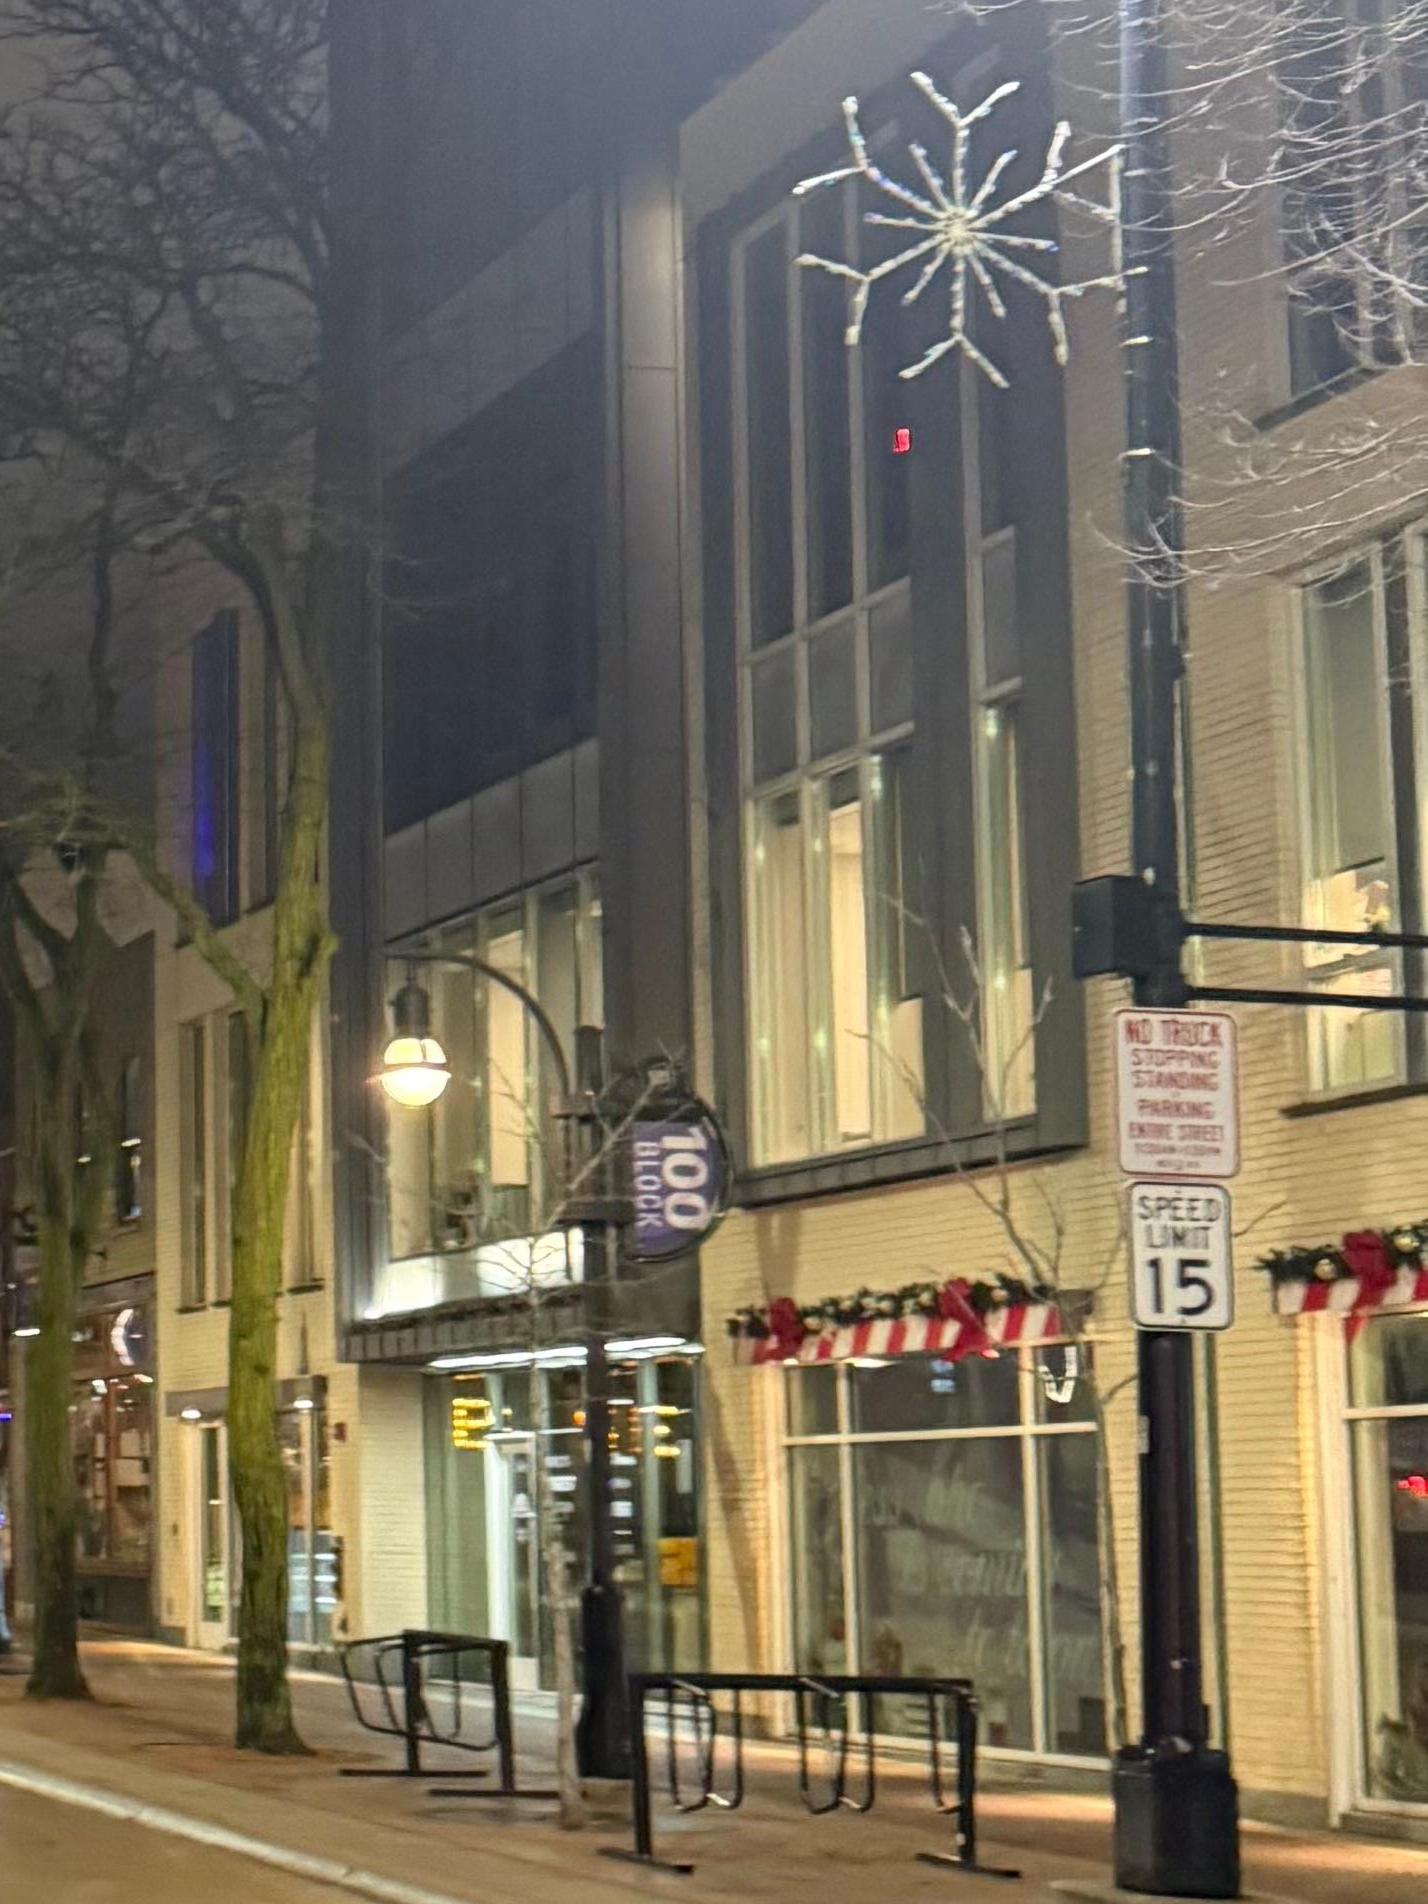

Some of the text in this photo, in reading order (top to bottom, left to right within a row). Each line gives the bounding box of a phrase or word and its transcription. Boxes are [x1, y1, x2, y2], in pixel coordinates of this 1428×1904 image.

[1126, 1020, 1223, 1046] NO TRUCK
[1131, 1049, 1219, 1069] STOPPING
[1131, 1070, 1219, 1091] STANDING
[1137, 1099, 1214, 1119] PARKING
[633, 1142, 662, 1227] BLOCK
[660, 1127, 711, 1230] 100
[1137, 1196, 1221, 1222] SPEED
[1145, 1224, 1211, 1249] LIMIT
[1146, 1257, 1215, 1316] 15
